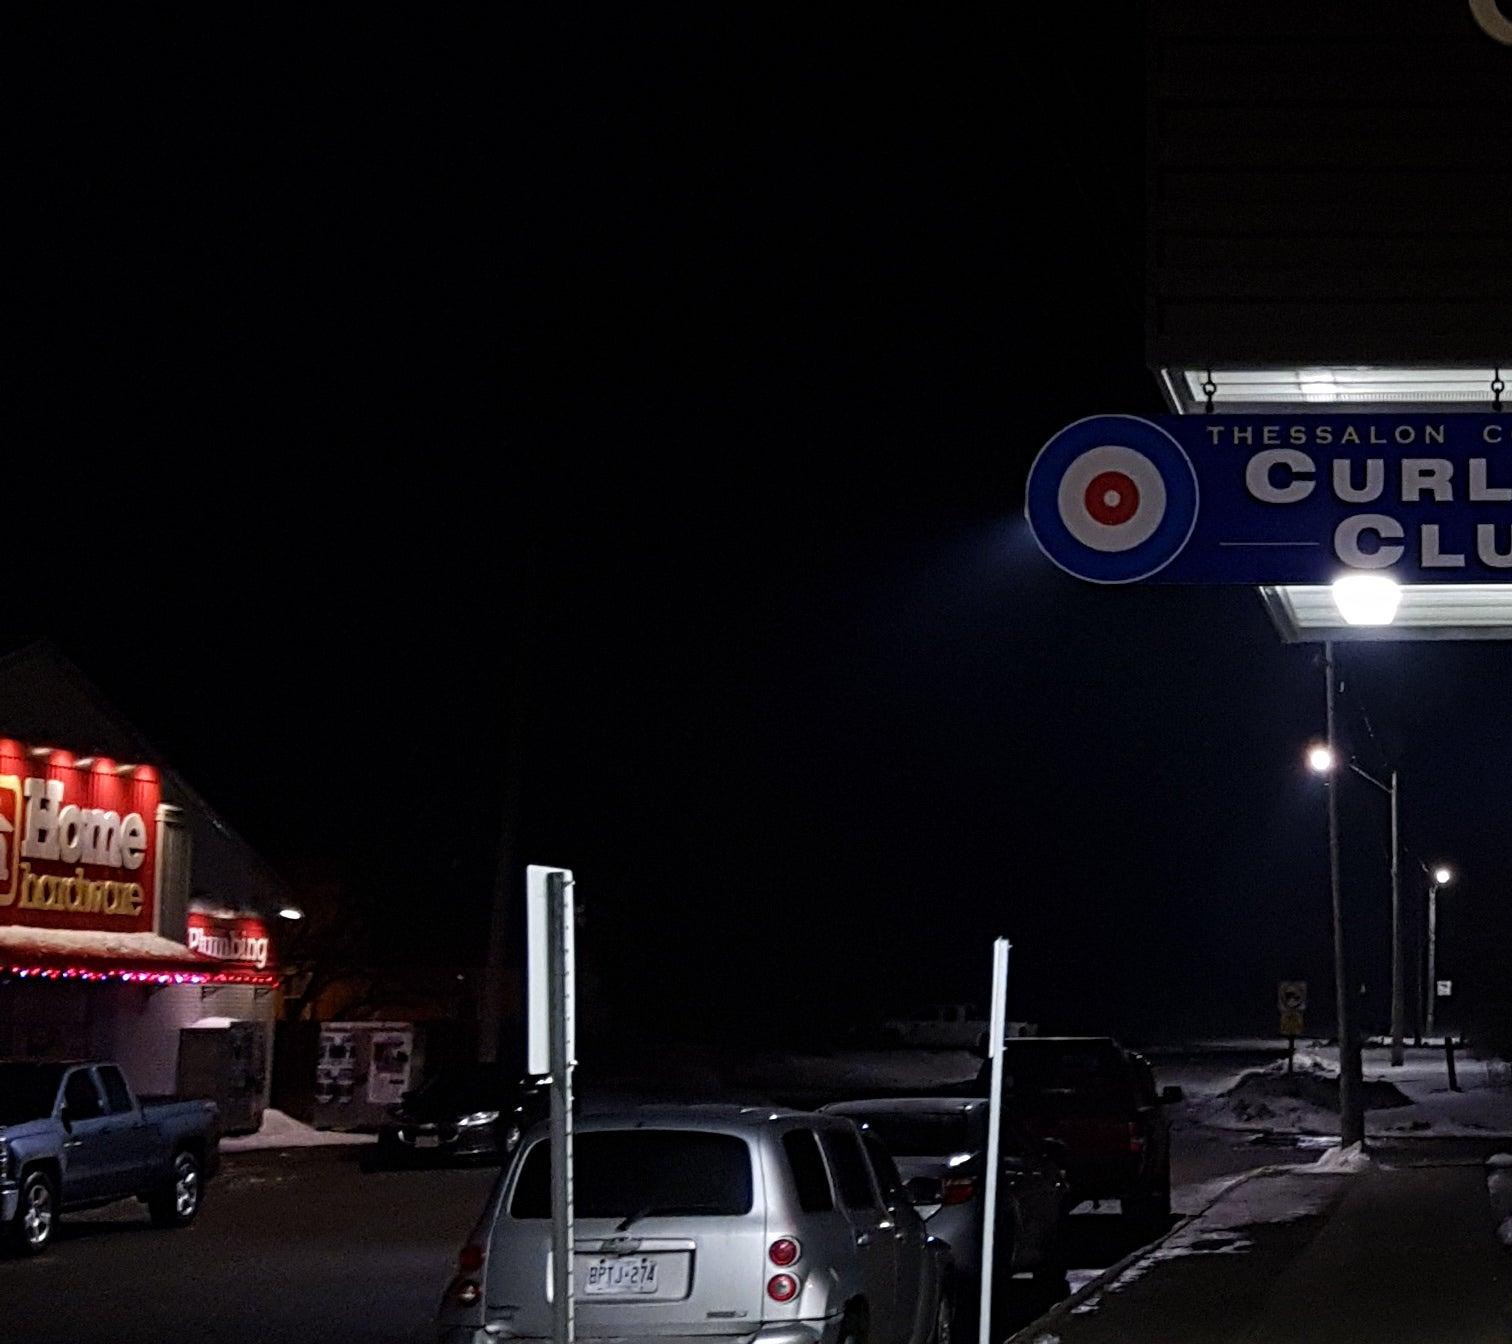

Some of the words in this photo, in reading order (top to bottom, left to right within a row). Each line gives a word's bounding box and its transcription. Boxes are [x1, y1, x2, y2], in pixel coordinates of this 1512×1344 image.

[1206, 424, 1446, 445] THESSALON
[21, 777, 148, 871] Home
[18, 861, 144, 917] hardware
[188, 926, 269, 969] Plumbing
